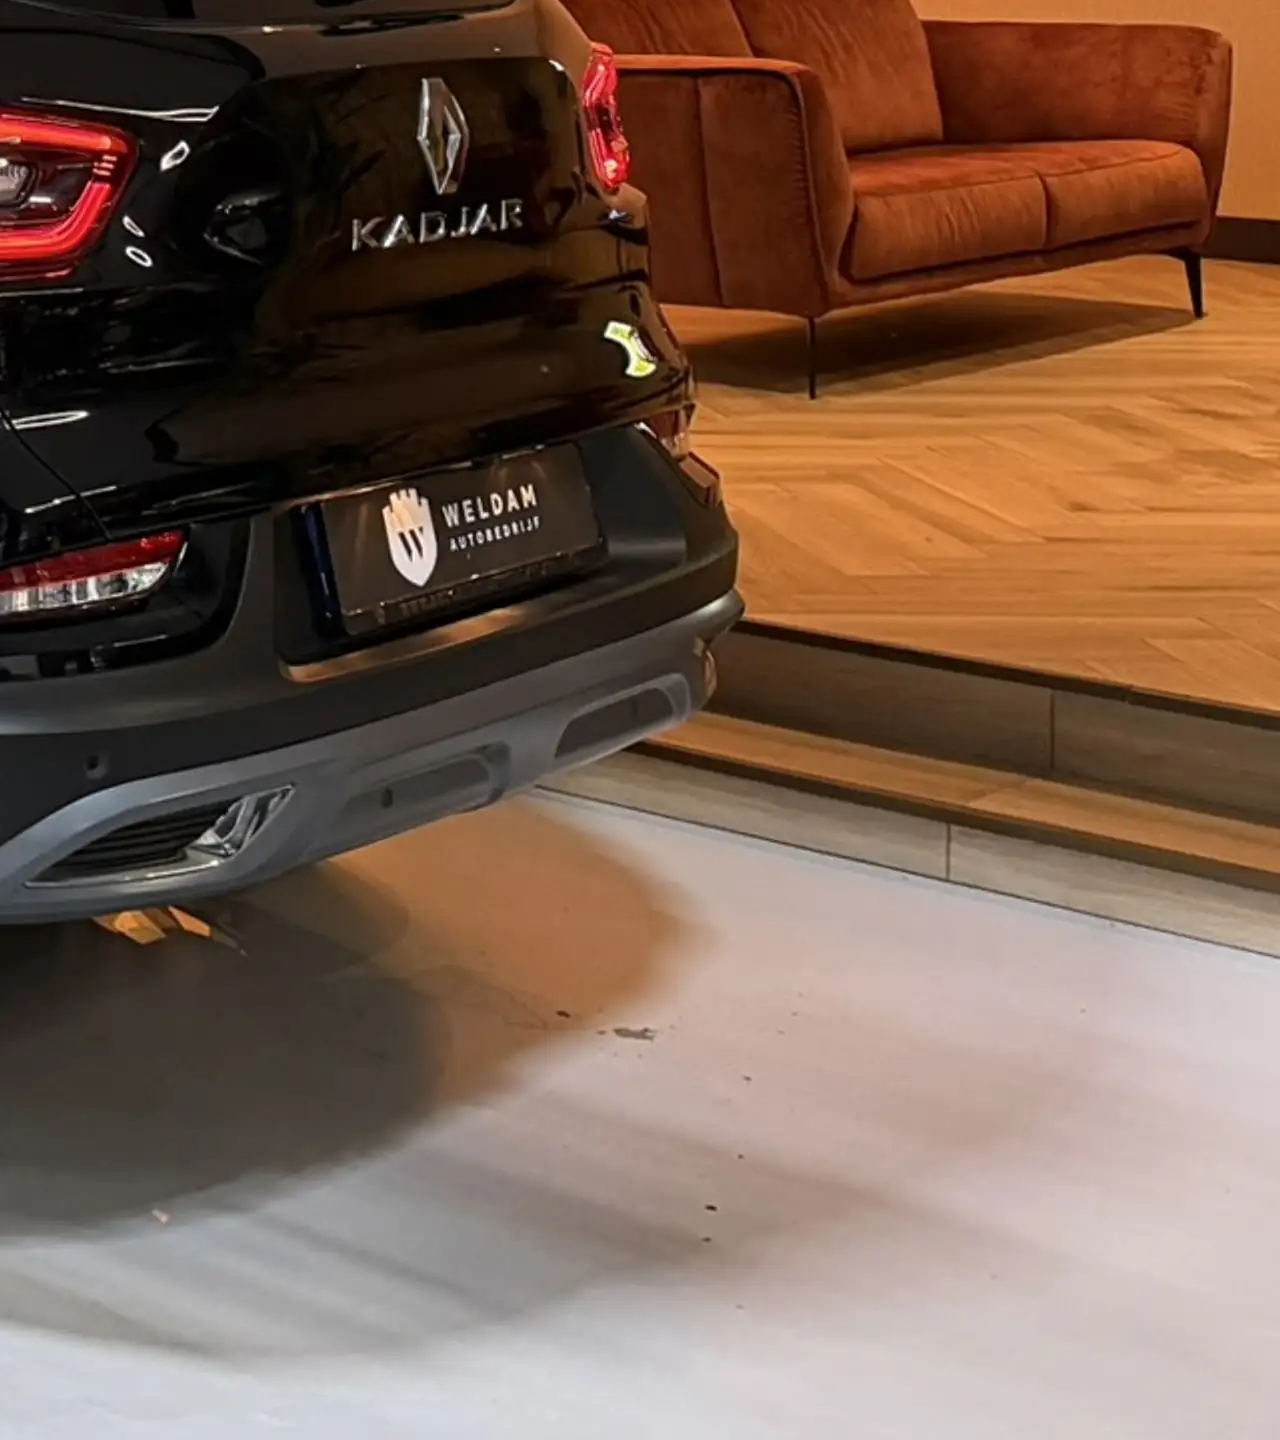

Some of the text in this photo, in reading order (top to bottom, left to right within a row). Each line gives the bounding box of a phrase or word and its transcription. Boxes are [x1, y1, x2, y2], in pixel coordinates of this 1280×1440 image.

[351, 198, 523, 251] KADJAR
[442, 484, 538, 529] WELDAM
[449, 516, 541, 552] AUTOBEDRIJF
